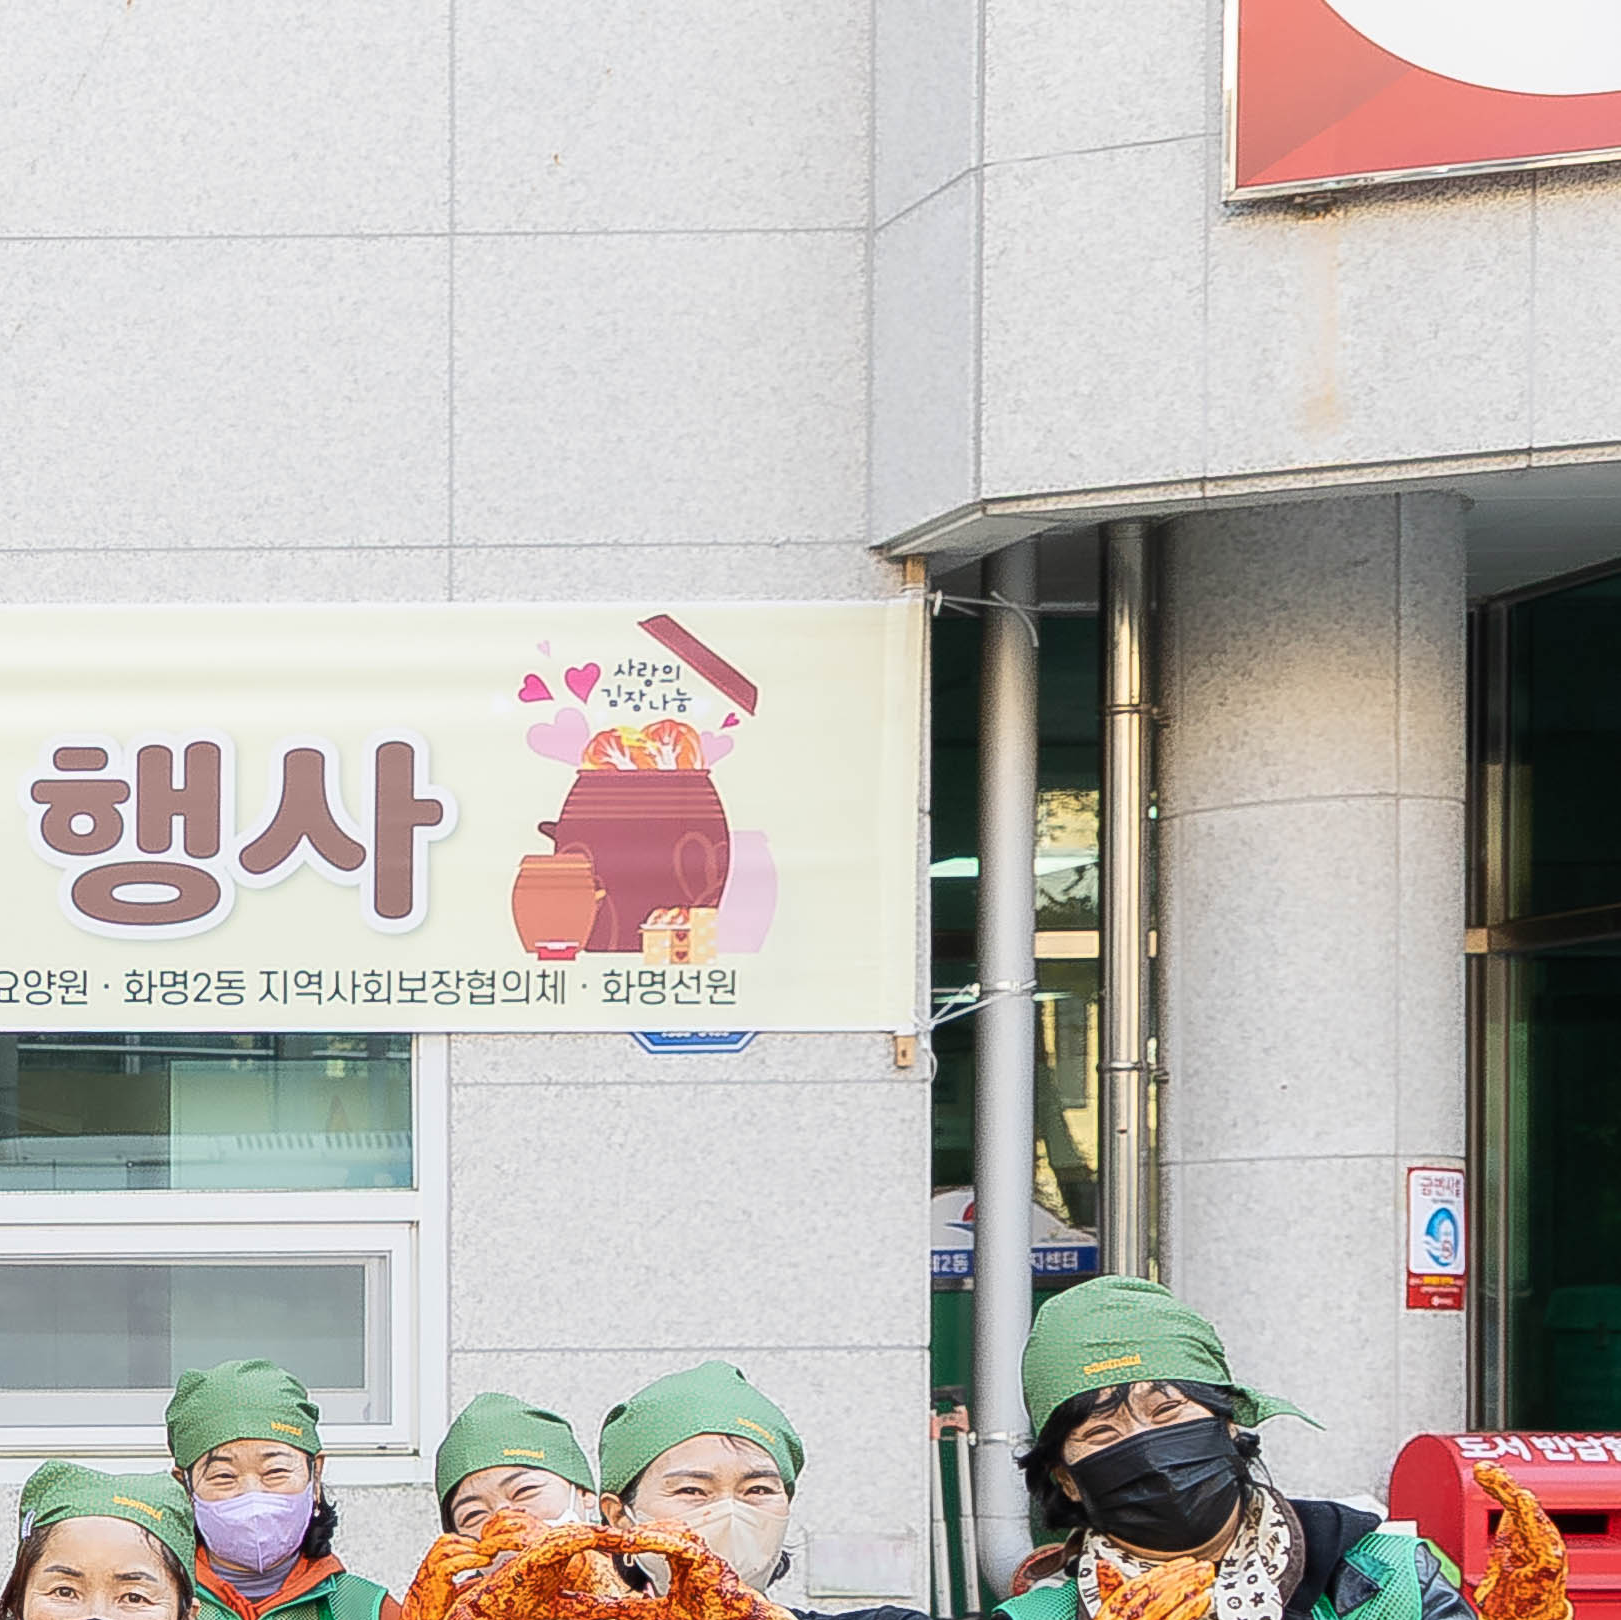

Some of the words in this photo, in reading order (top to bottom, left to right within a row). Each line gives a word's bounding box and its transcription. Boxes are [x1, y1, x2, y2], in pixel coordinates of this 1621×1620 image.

[614, 659, 682, 687] 사랑의
[30, 741, 443, 933] 행사
[123, 969, 247, 1006] 화명2동
[258, 969, 566, 1006] 지역사회보장협의체
[602, 969, 737, 1006] 화명선원
[1455, 1435, 1532, 1462] 도서
